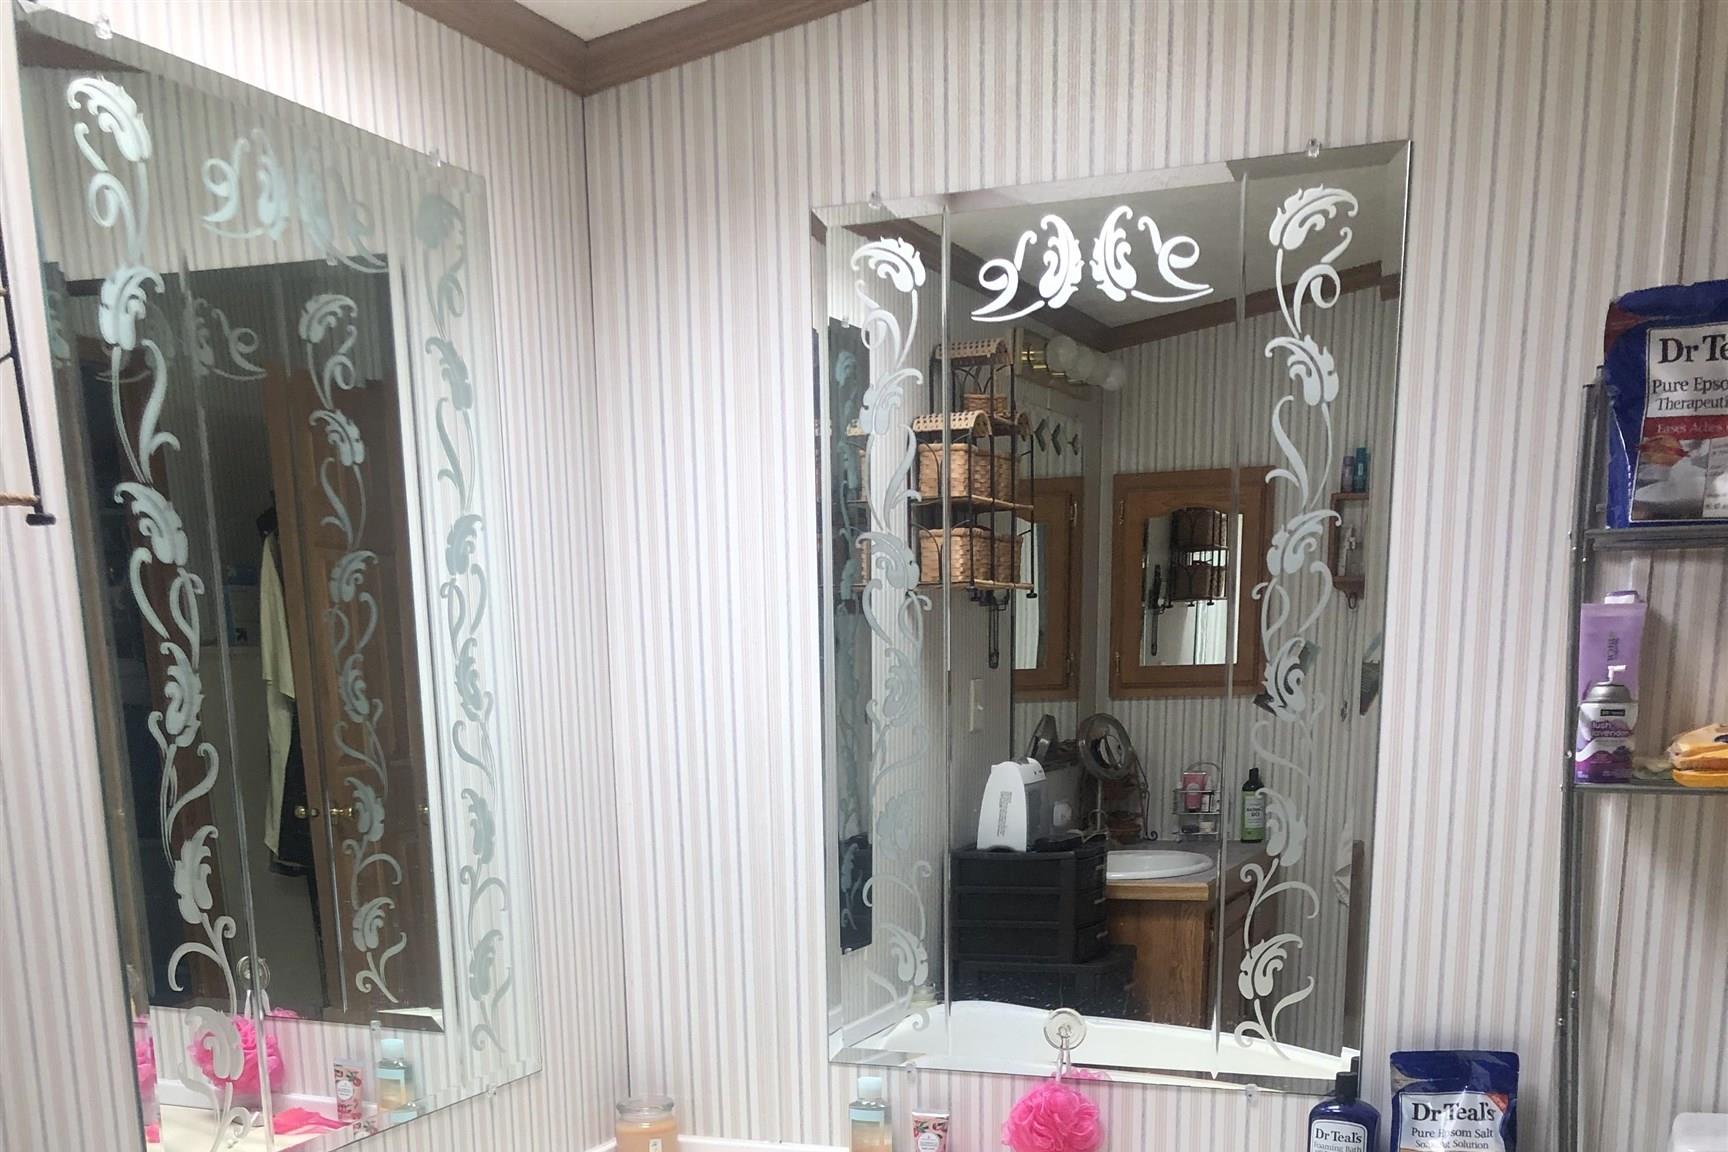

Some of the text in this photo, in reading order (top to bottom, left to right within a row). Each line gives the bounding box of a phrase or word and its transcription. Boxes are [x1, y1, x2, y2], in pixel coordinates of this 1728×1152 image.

[1658, 337, 1699, 364] Dr
[1652, 378, 1689, 394] Pure
[1411, 1102, 1496, 1122] Dr Teal's
[1315, 1128, 1362, 1144] Dr Teal's
[1411, 1127, 1436, 1138] Pure
[1474, 1127, 1494, 1139] Salt
[1452, 1140, 1489, 1150] Solution
